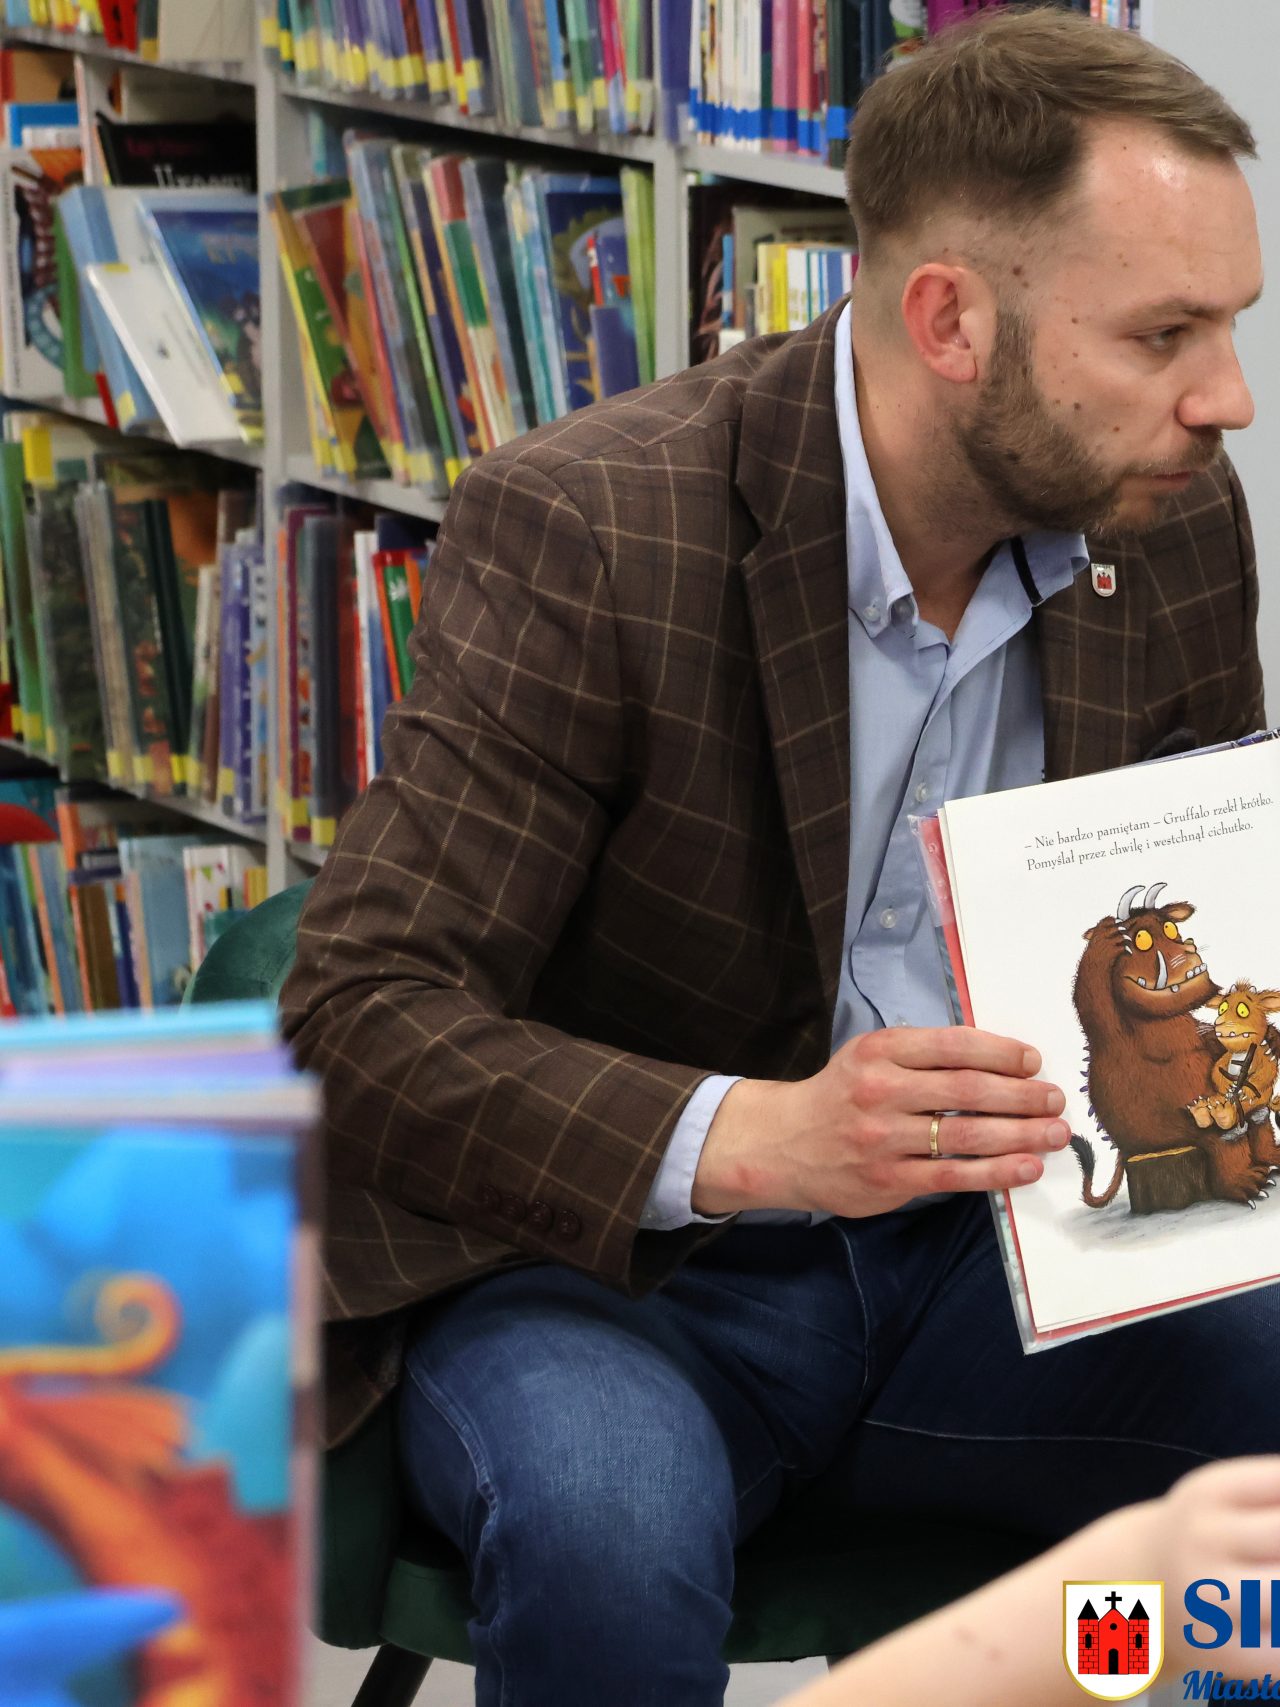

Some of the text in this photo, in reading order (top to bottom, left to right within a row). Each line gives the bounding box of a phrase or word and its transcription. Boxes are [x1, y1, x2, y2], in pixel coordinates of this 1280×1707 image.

[1026, 818, 1254, 871] Pomyślał przez chwilę i westchnął cichutko.
[1035, 836, 1055, 849] Nie
[1057, 828, 1094, 845] bardzo
[1097, 820, 1150, 841] pamiętam
[1163, 805, 1210, 826] Gruffalo
[1213, 799, 1238, 816] rzekł
[1240, 793, 1274, 810] krótko.
